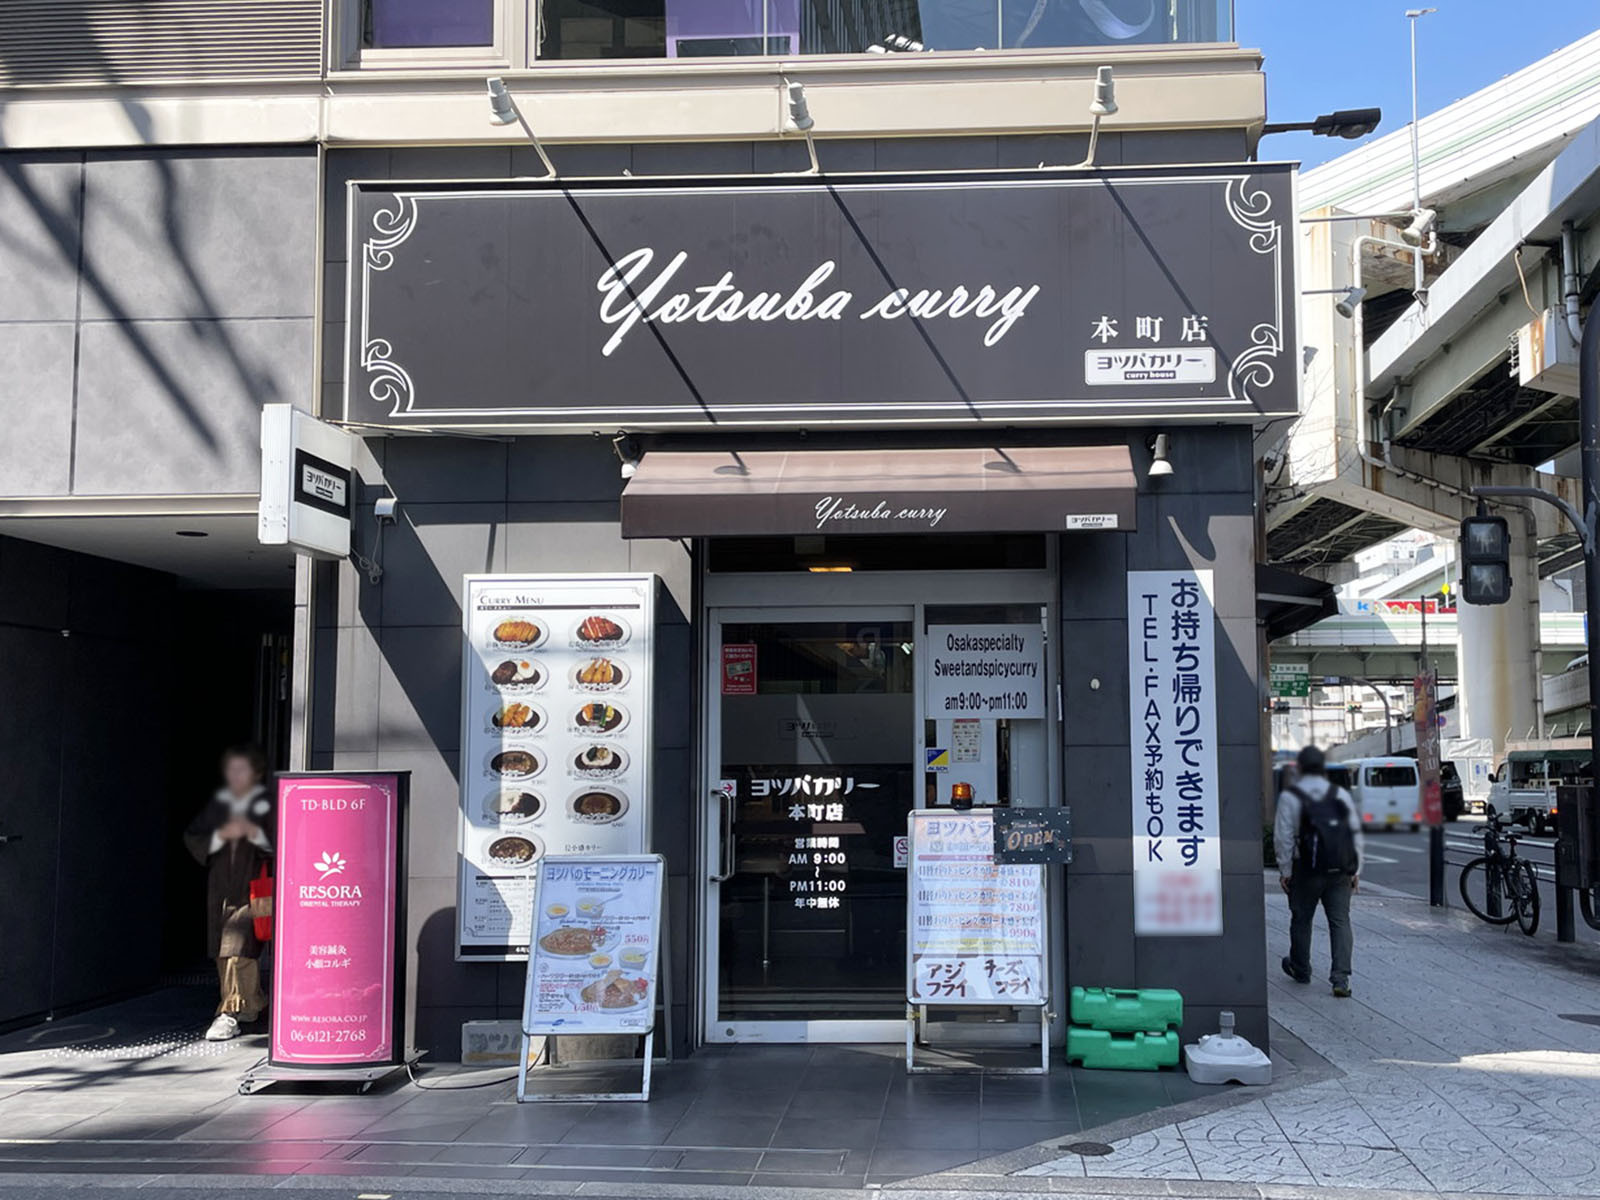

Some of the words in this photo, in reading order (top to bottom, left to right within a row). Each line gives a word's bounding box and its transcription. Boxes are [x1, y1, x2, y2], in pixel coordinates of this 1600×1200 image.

[596, 248, 852, 357] Yotsuba
[860, 284, 1040, 347] curry
[1091, 315, 1208, 343] 本町店
[1097, 353, 1203, 369] ヨツバカリー
[1126, 372, 1148, 380] curry
[1150, 371, 1174, 379] house
[815, 496, 891, 529] Yotsuba
[894, 508, 947, 527] curry
[946, 633, 1025, 653] Osakaspecialty
[934, 658, 1038, 678] Sweetandspicycurry
[1171, 578, 1206, 867] お持ち帰りできます
[751, 774, 880, 796] ヨツバカリー
[351, 798, 366, 811] 6F
[788, 803, 843, 821] 本町店
[795, 837, 840, 849] 営業時間
[788, 853, 808, 864] AM
[813, 852, 846, 864] 9:00
[299, 885, 362, 899] RESORA
[795, 897, 840, 909] 年中無休
[926, 961, 966, 979] アジ
[984, 959, 1023, 979] チーズ
[926, 979, 968, 998] フライ
[290, 1029, 366, 1042] 06-6121-2768
